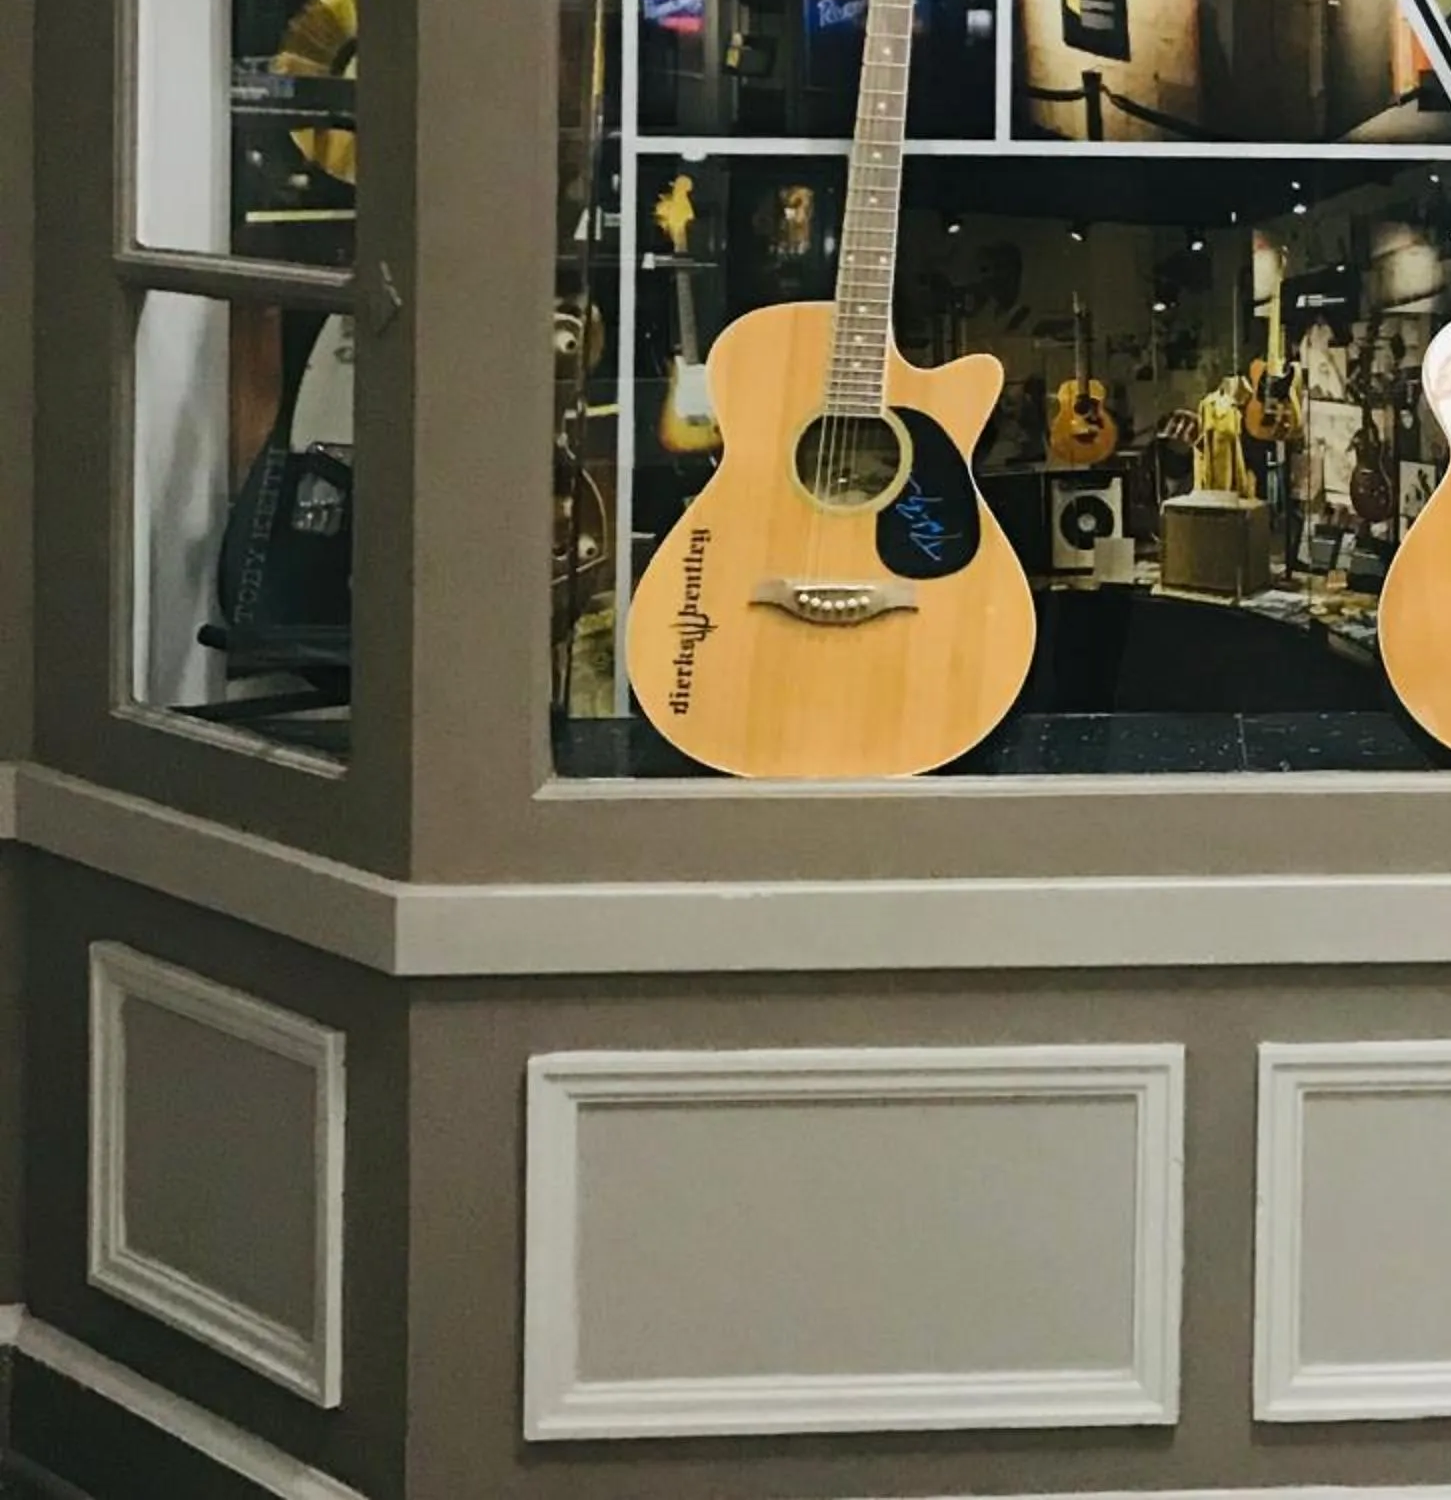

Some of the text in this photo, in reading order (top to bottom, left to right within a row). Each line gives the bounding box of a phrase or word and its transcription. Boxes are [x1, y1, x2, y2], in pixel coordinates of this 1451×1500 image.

[232, 547, 266, 625] TOBY
[677, 528, 711, 617] bentley
[668, 639, 696, 716] dierks
